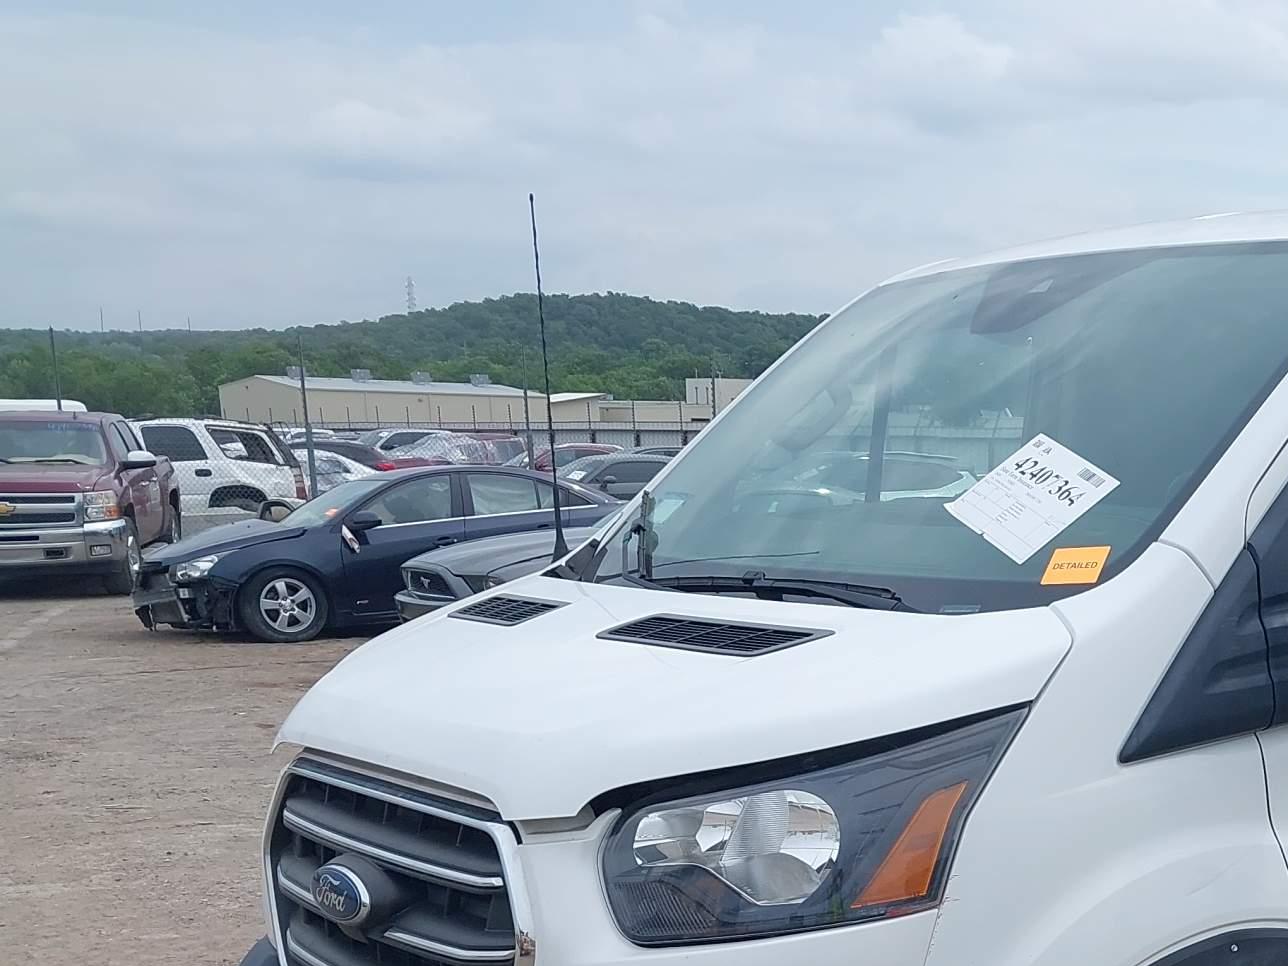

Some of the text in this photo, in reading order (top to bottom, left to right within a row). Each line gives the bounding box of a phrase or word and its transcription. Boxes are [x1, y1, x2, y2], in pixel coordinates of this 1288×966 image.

[1013, 456, 1087, 507] 42407364
[1052, 561, 1098, 570] DETAILED
[316, 873, 348, 912] Ford
